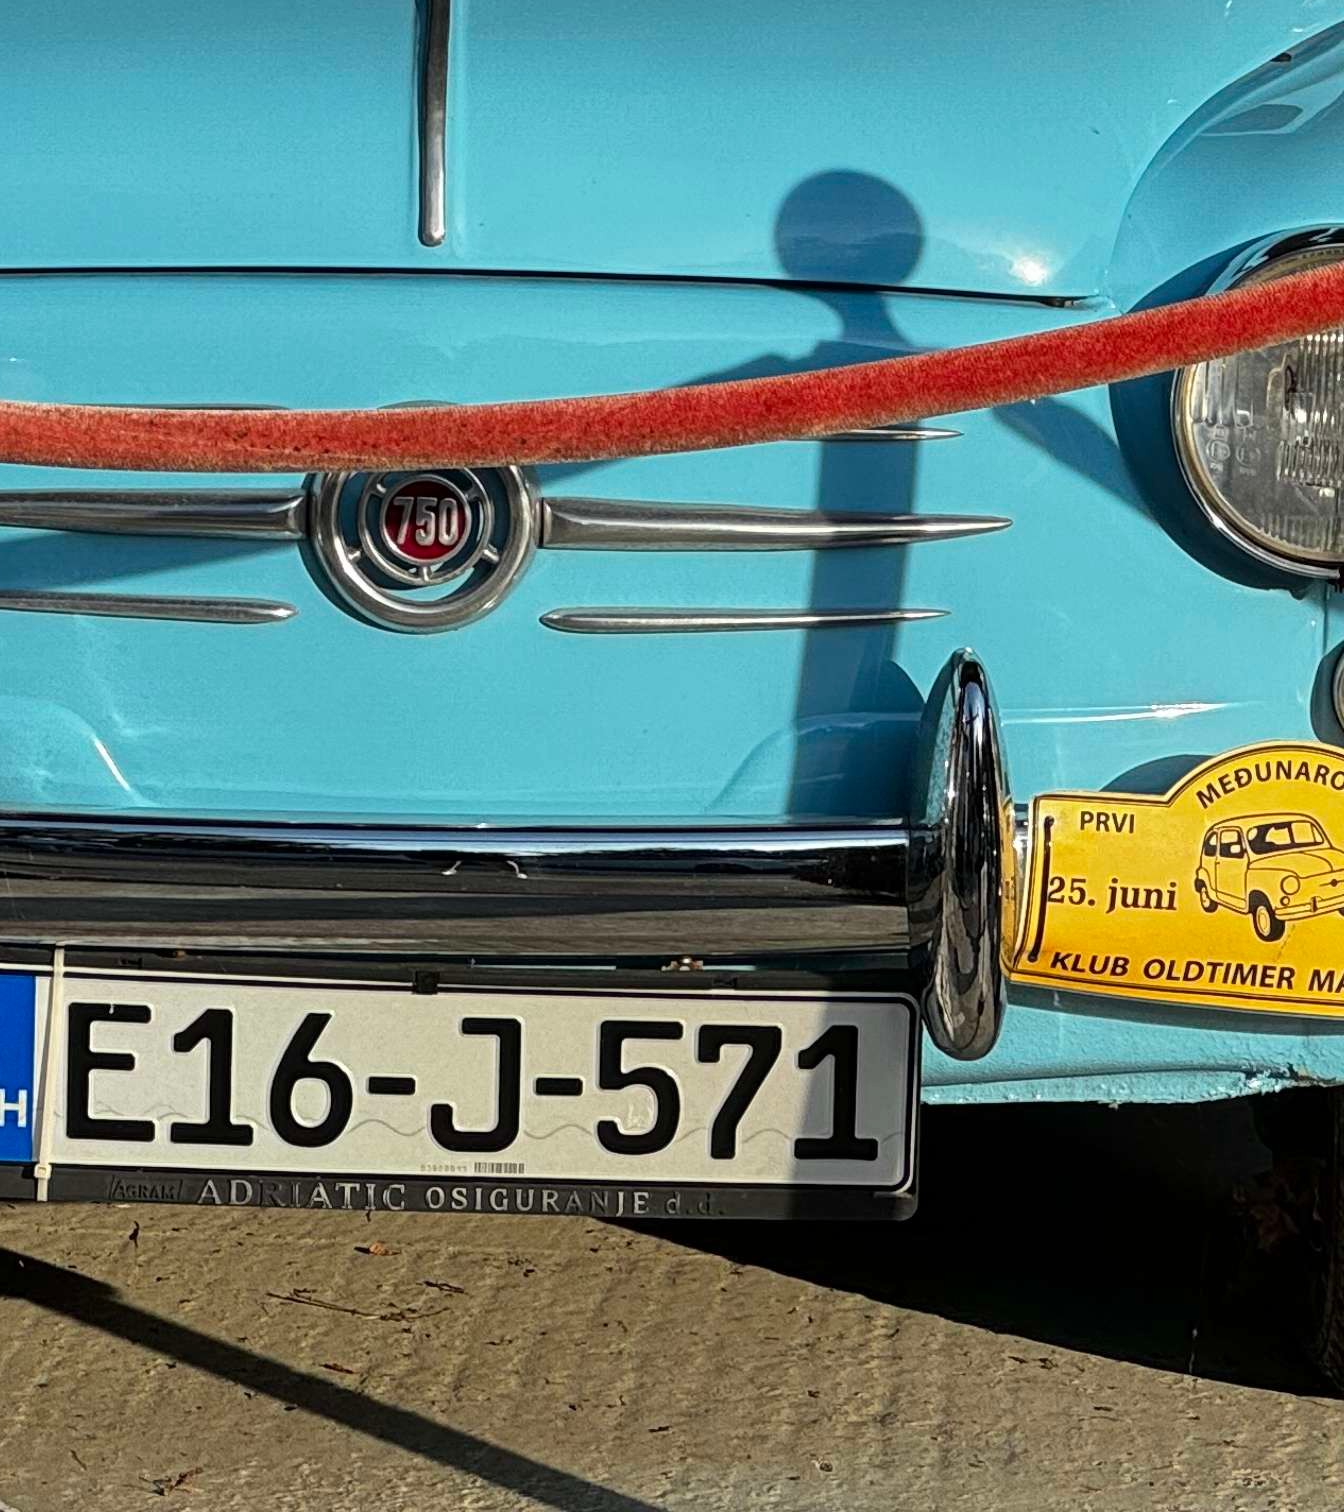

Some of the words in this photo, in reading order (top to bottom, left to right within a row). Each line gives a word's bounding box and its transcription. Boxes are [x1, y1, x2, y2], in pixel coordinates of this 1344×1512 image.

[393, 496, 459, 546] 750
[1079, 810, 1136, 834] PRVI
[1047, 876, 1097, 907] 25.
[1104, 880, 1178, 915] juni
[1050, 951, 1130, 978] KLUB
[1143, 957, 1295, 990] OLDTIMER
[65, 1002, 881, 1163] E16-J-571
[197, 1177, 406, 1210] ADRIATIC
[425, 1186, 651, 1217] OSIGURANJE
